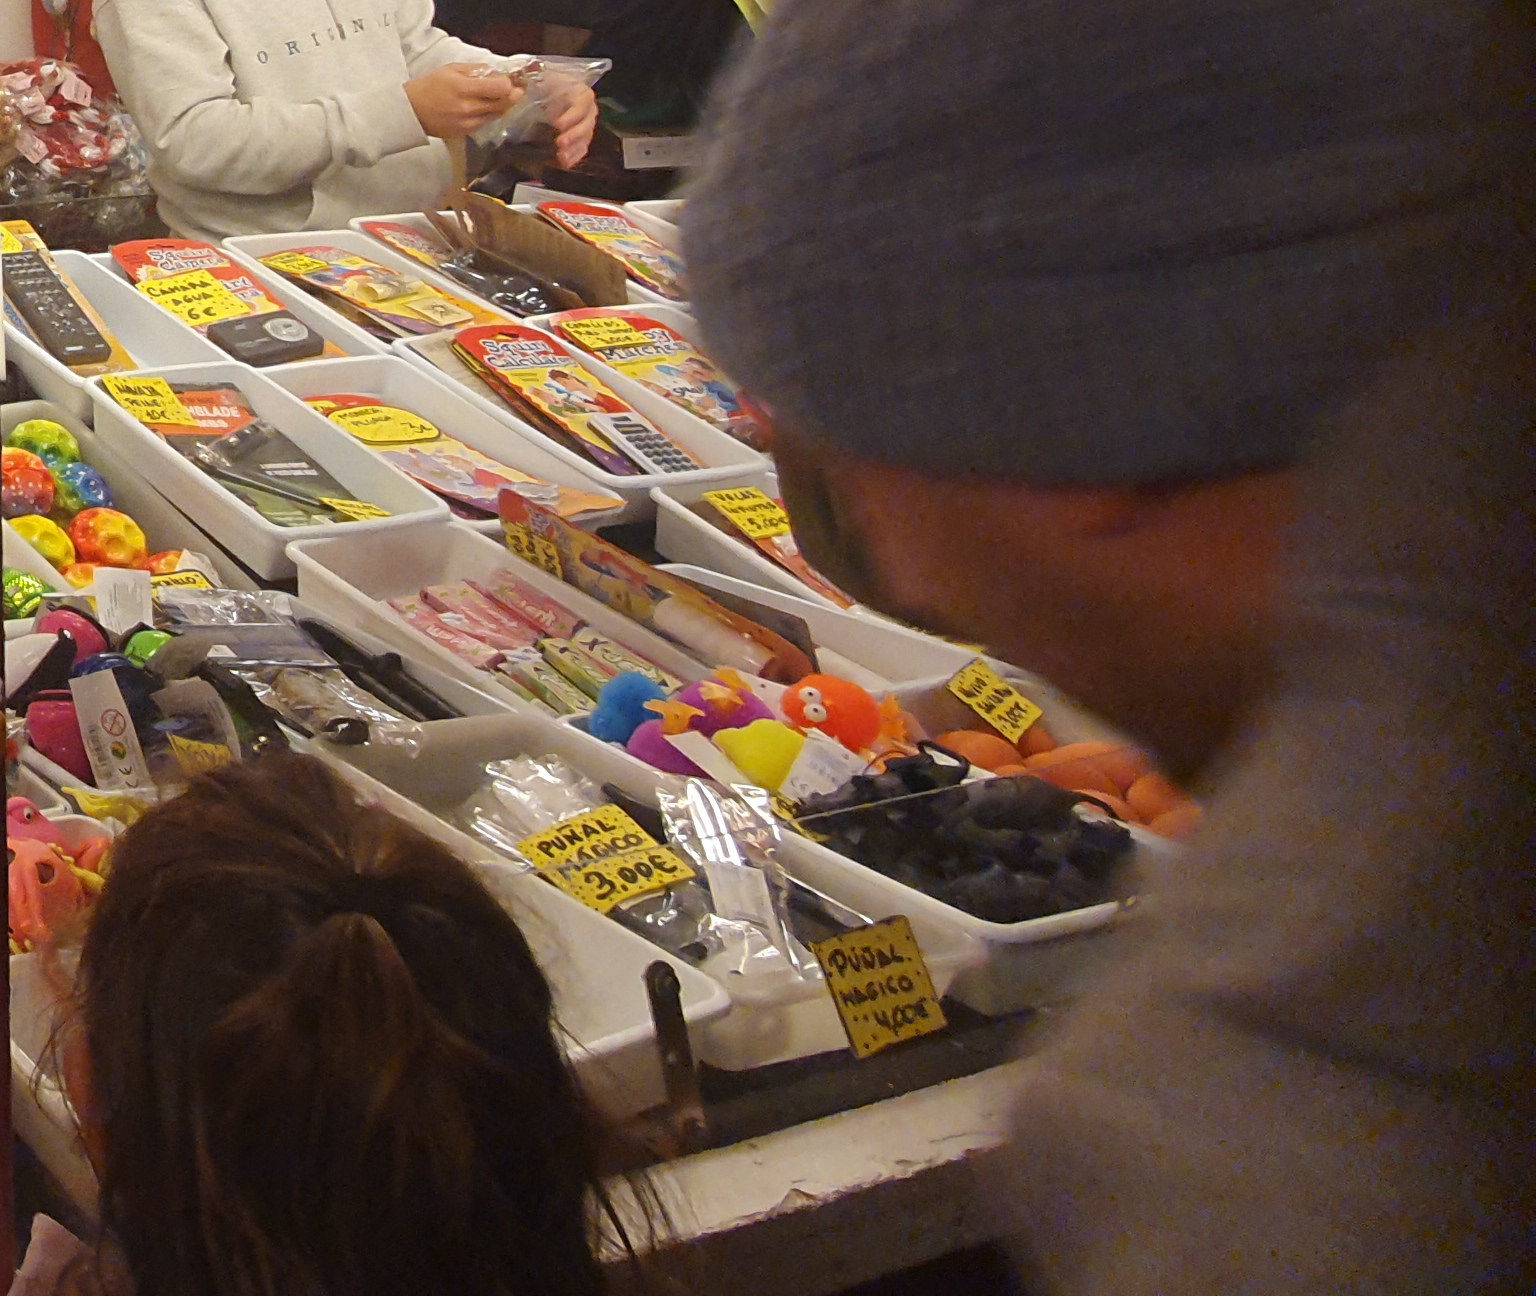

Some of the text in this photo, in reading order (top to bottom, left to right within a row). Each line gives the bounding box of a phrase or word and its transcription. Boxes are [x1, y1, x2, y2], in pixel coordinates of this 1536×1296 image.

[256, 13, 390, 64] ORINL
[170, 291, 214, 307] AGUA
[540, 817, 617, 859] PUÑAL
